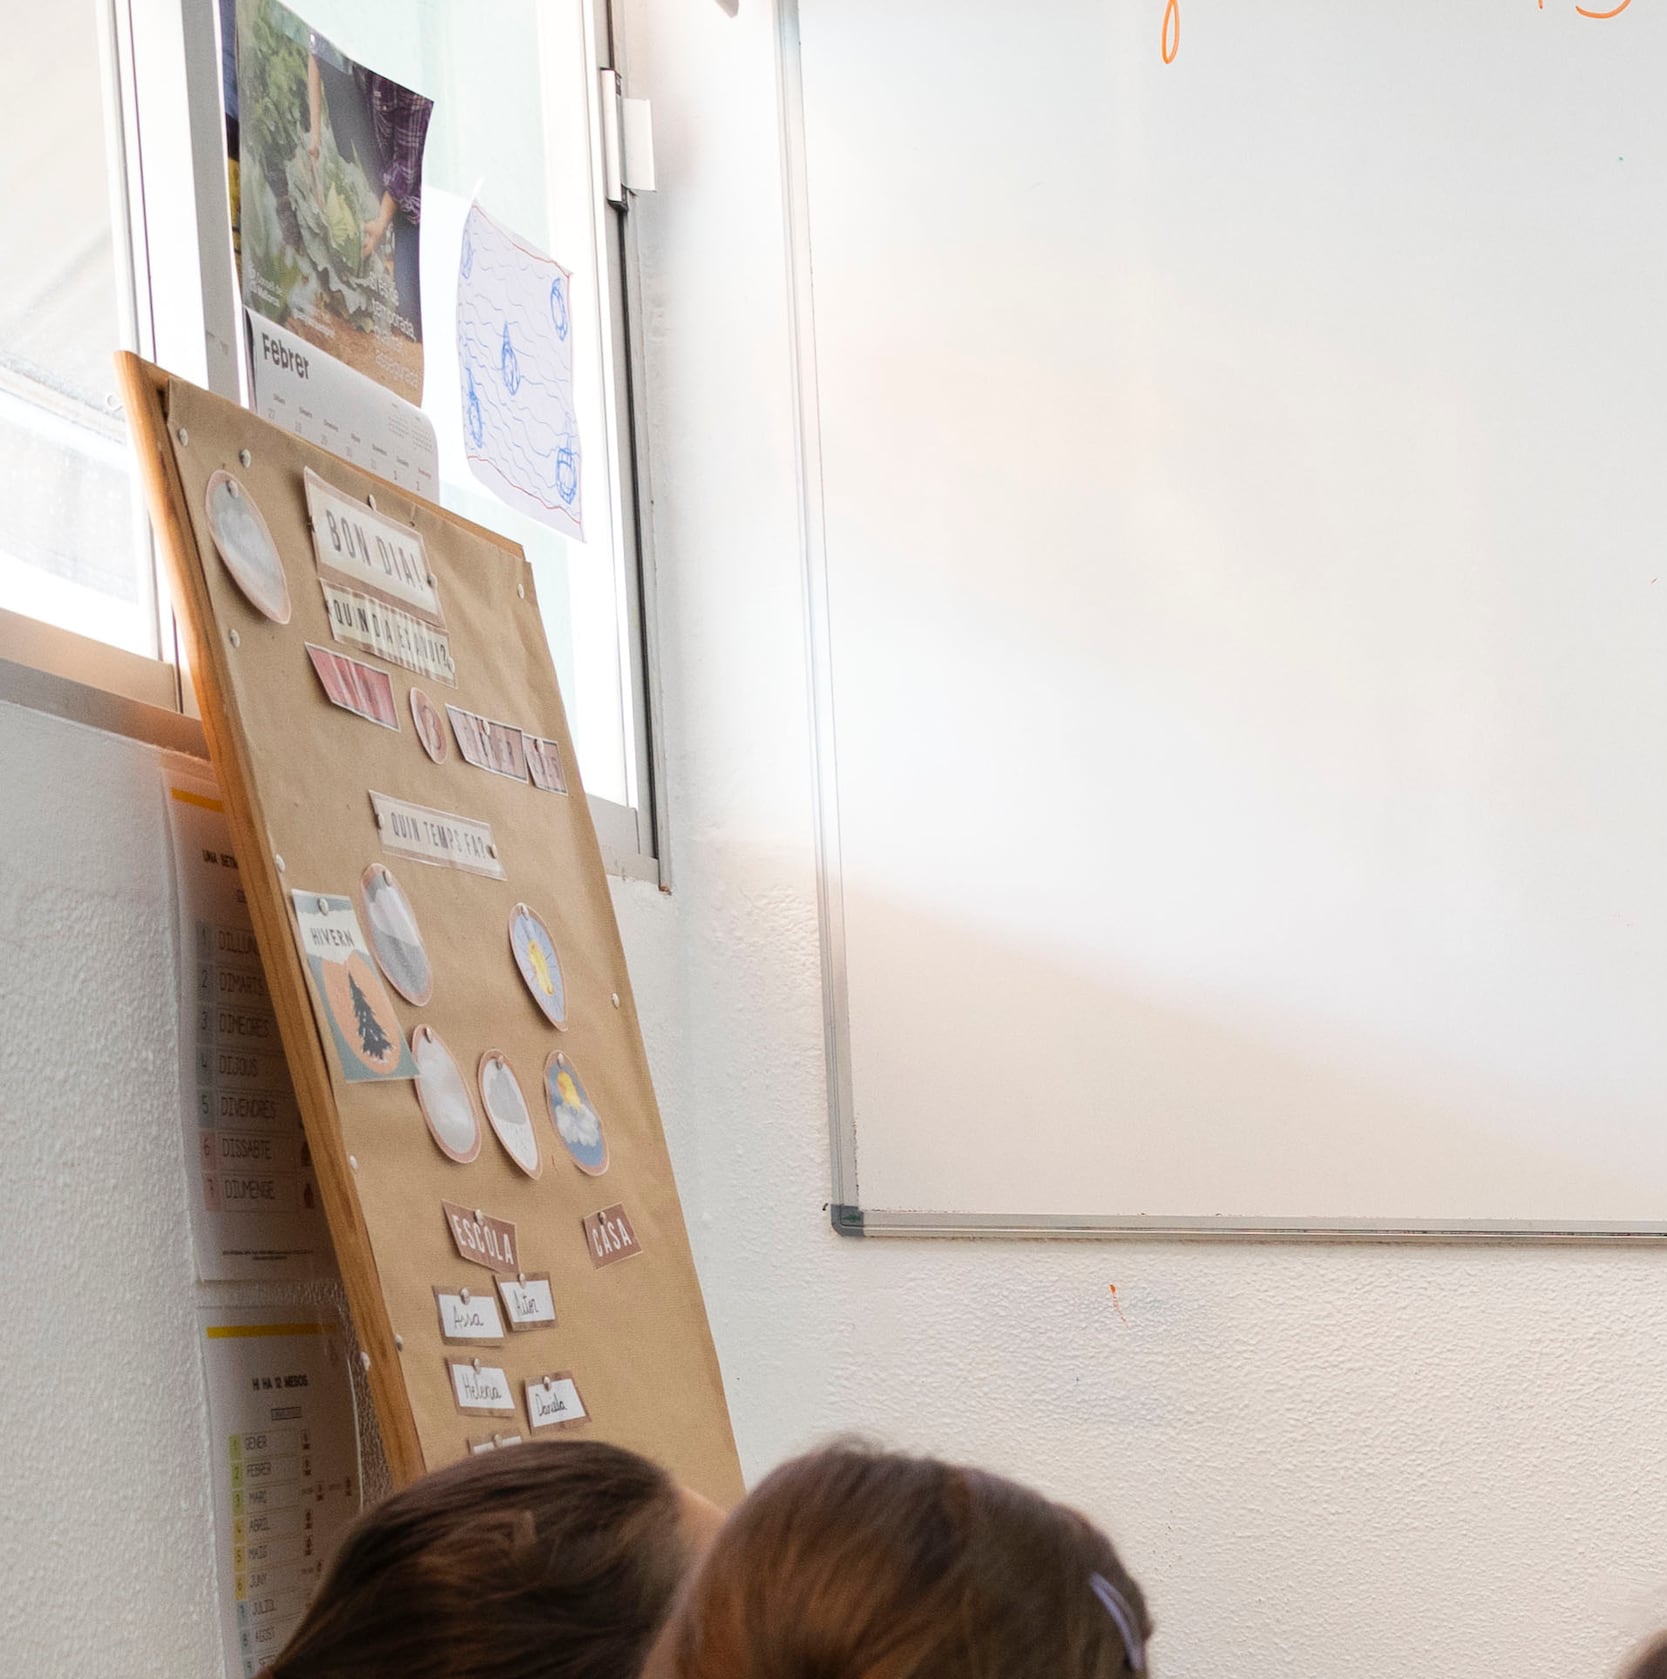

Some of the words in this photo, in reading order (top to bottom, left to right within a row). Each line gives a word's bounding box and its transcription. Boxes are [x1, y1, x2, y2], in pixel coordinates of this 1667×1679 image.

[262, 332, 310, 381] Febrer
[326, 508, 372, 567] BON
[375, 534, 424, 592] DIA!
[391, 811, 421, 842] QUIN
[423, 820, 463, 853] TEMPS
[309, 926, 356, 948] HIVERN
[201, 1094, 209, 1115] 5
[452, 1214, 515, 1266] ESCOLA
[591, 1217, 633, 1258] CASA
[462, 1373, 502, 1401] Helena
